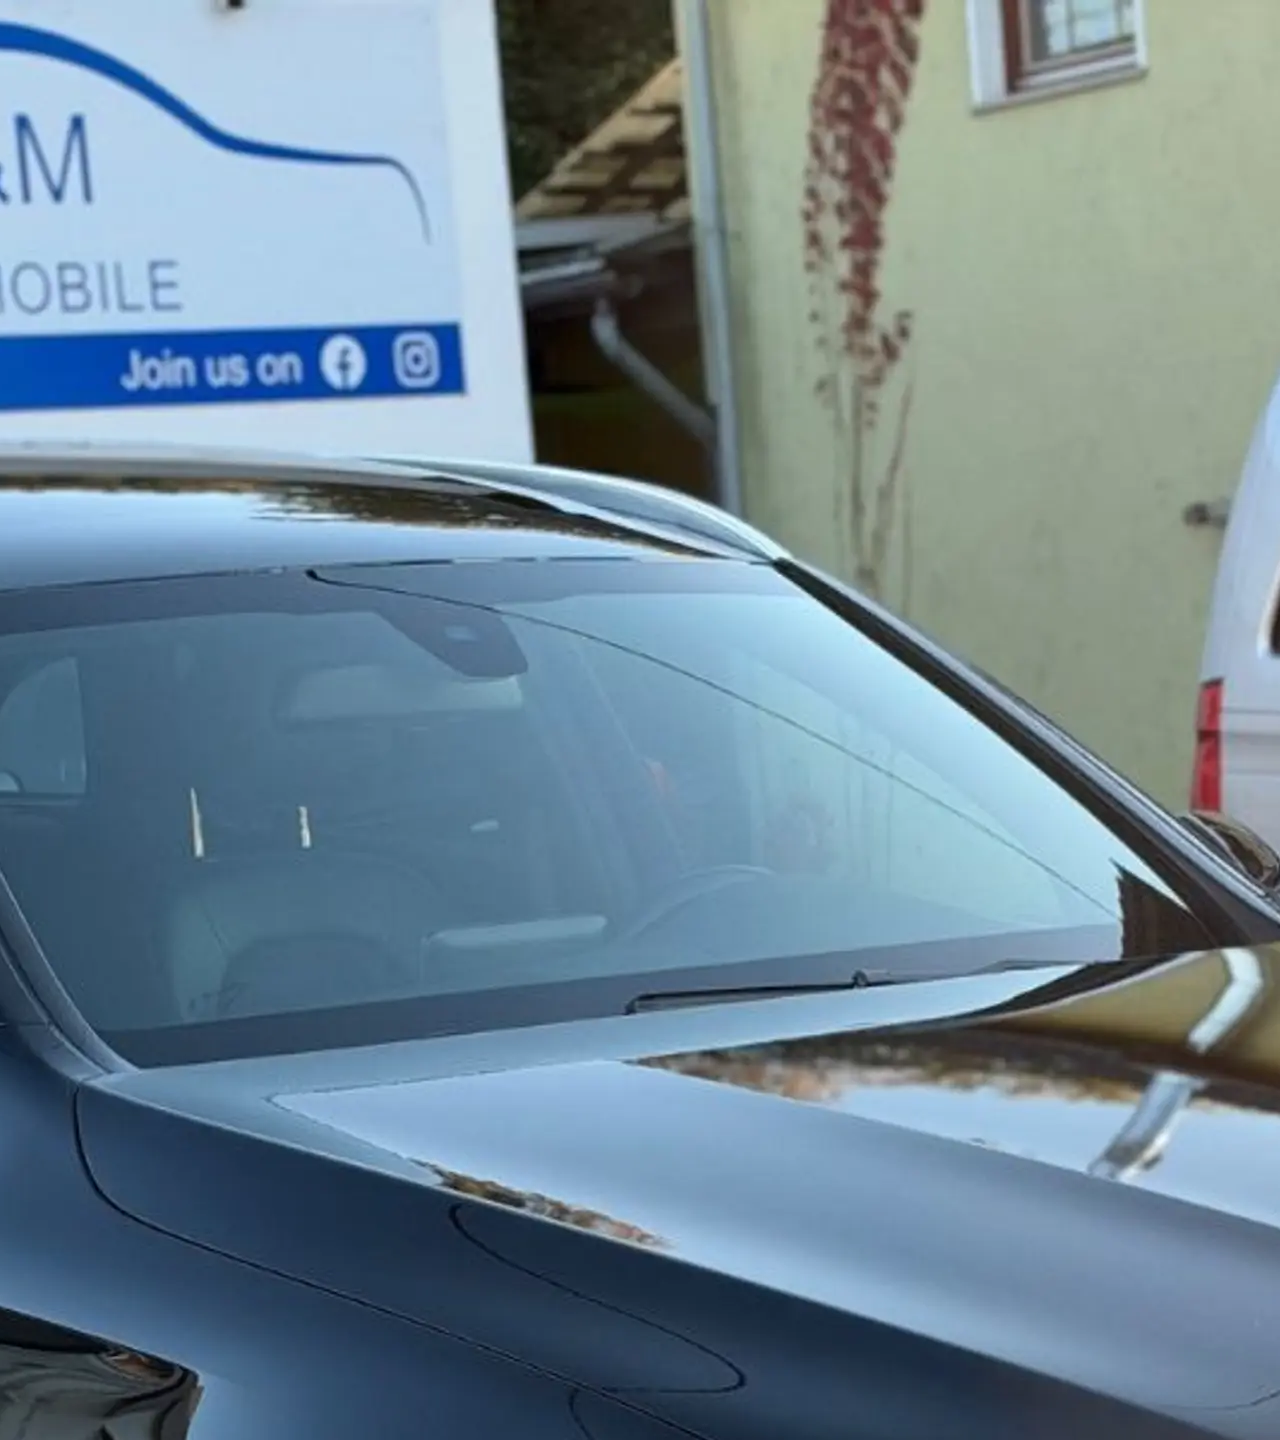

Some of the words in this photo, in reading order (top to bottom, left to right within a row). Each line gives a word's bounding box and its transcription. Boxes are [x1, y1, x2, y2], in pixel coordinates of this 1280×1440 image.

[120, 349, 197, 391] Join
[204, 354, 250, 388] us
[256, 353, 304, 387] on
